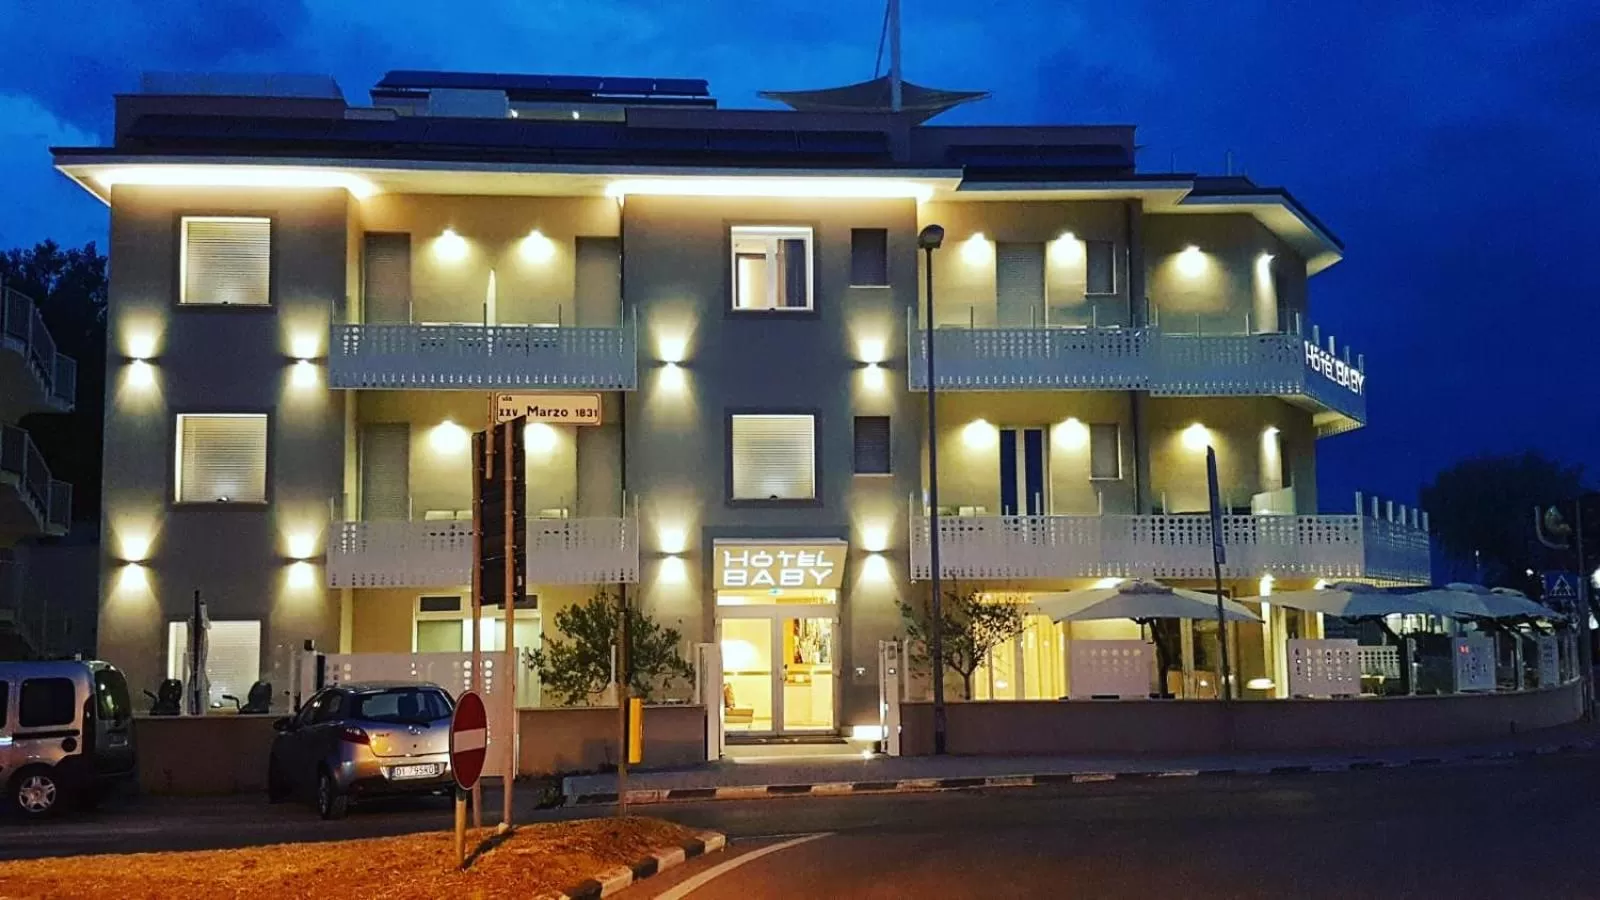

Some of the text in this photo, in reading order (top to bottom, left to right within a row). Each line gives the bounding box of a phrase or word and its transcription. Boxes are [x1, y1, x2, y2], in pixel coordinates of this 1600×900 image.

[1336, 360, 1365, 396] BABY
[527, 406, 568, 417] Marzo
[575, 409, 598, 418] 1831
[723, 568, 833, 586] BABY
